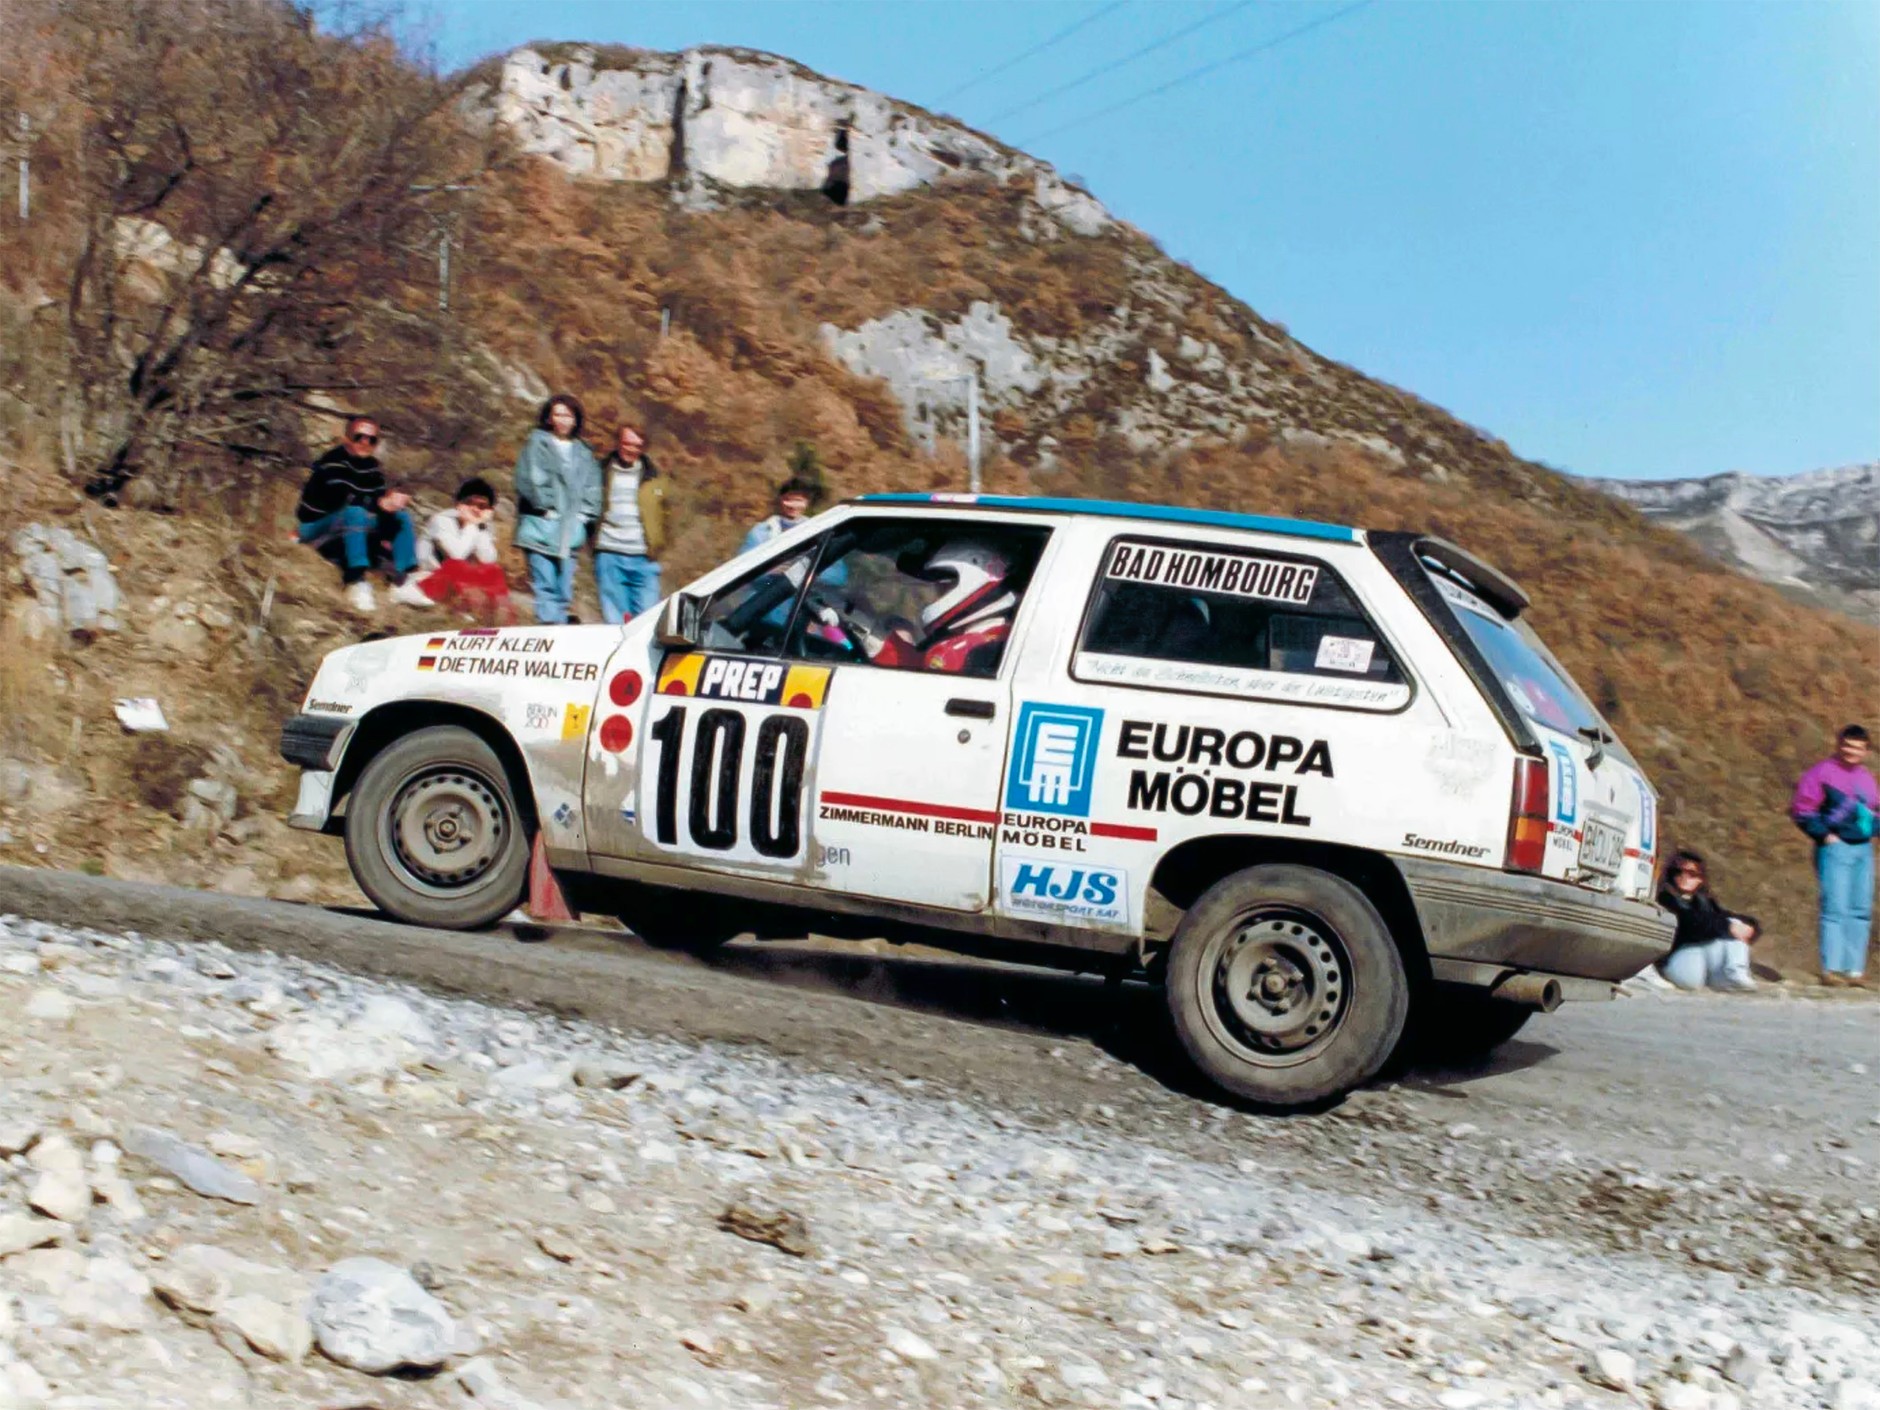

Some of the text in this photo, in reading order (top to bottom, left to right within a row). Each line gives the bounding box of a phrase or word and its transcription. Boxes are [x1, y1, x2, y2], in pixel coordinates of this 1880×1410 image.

[1109, 545, 1315, 601] BAD HOMBOURG
[446, 636, 555, 653] KURT KLEIN
[438, 656, 599, 681] DIETMAR WALTER
[701, 659, 783, 701] PREP
[1115, 719, 1335, 778] EUROPA
[650, 705, 810, 860] 100
[1126, 766, 1312, 827] MÖBEL
[819, 805, 993, 841] ZIMMERMANN BERLIN
[1003, 812, 1088, 835] EUROPA
[1401, 832, 1492, 858] Semdner
[1011, 863, 1118, 905] HJS
